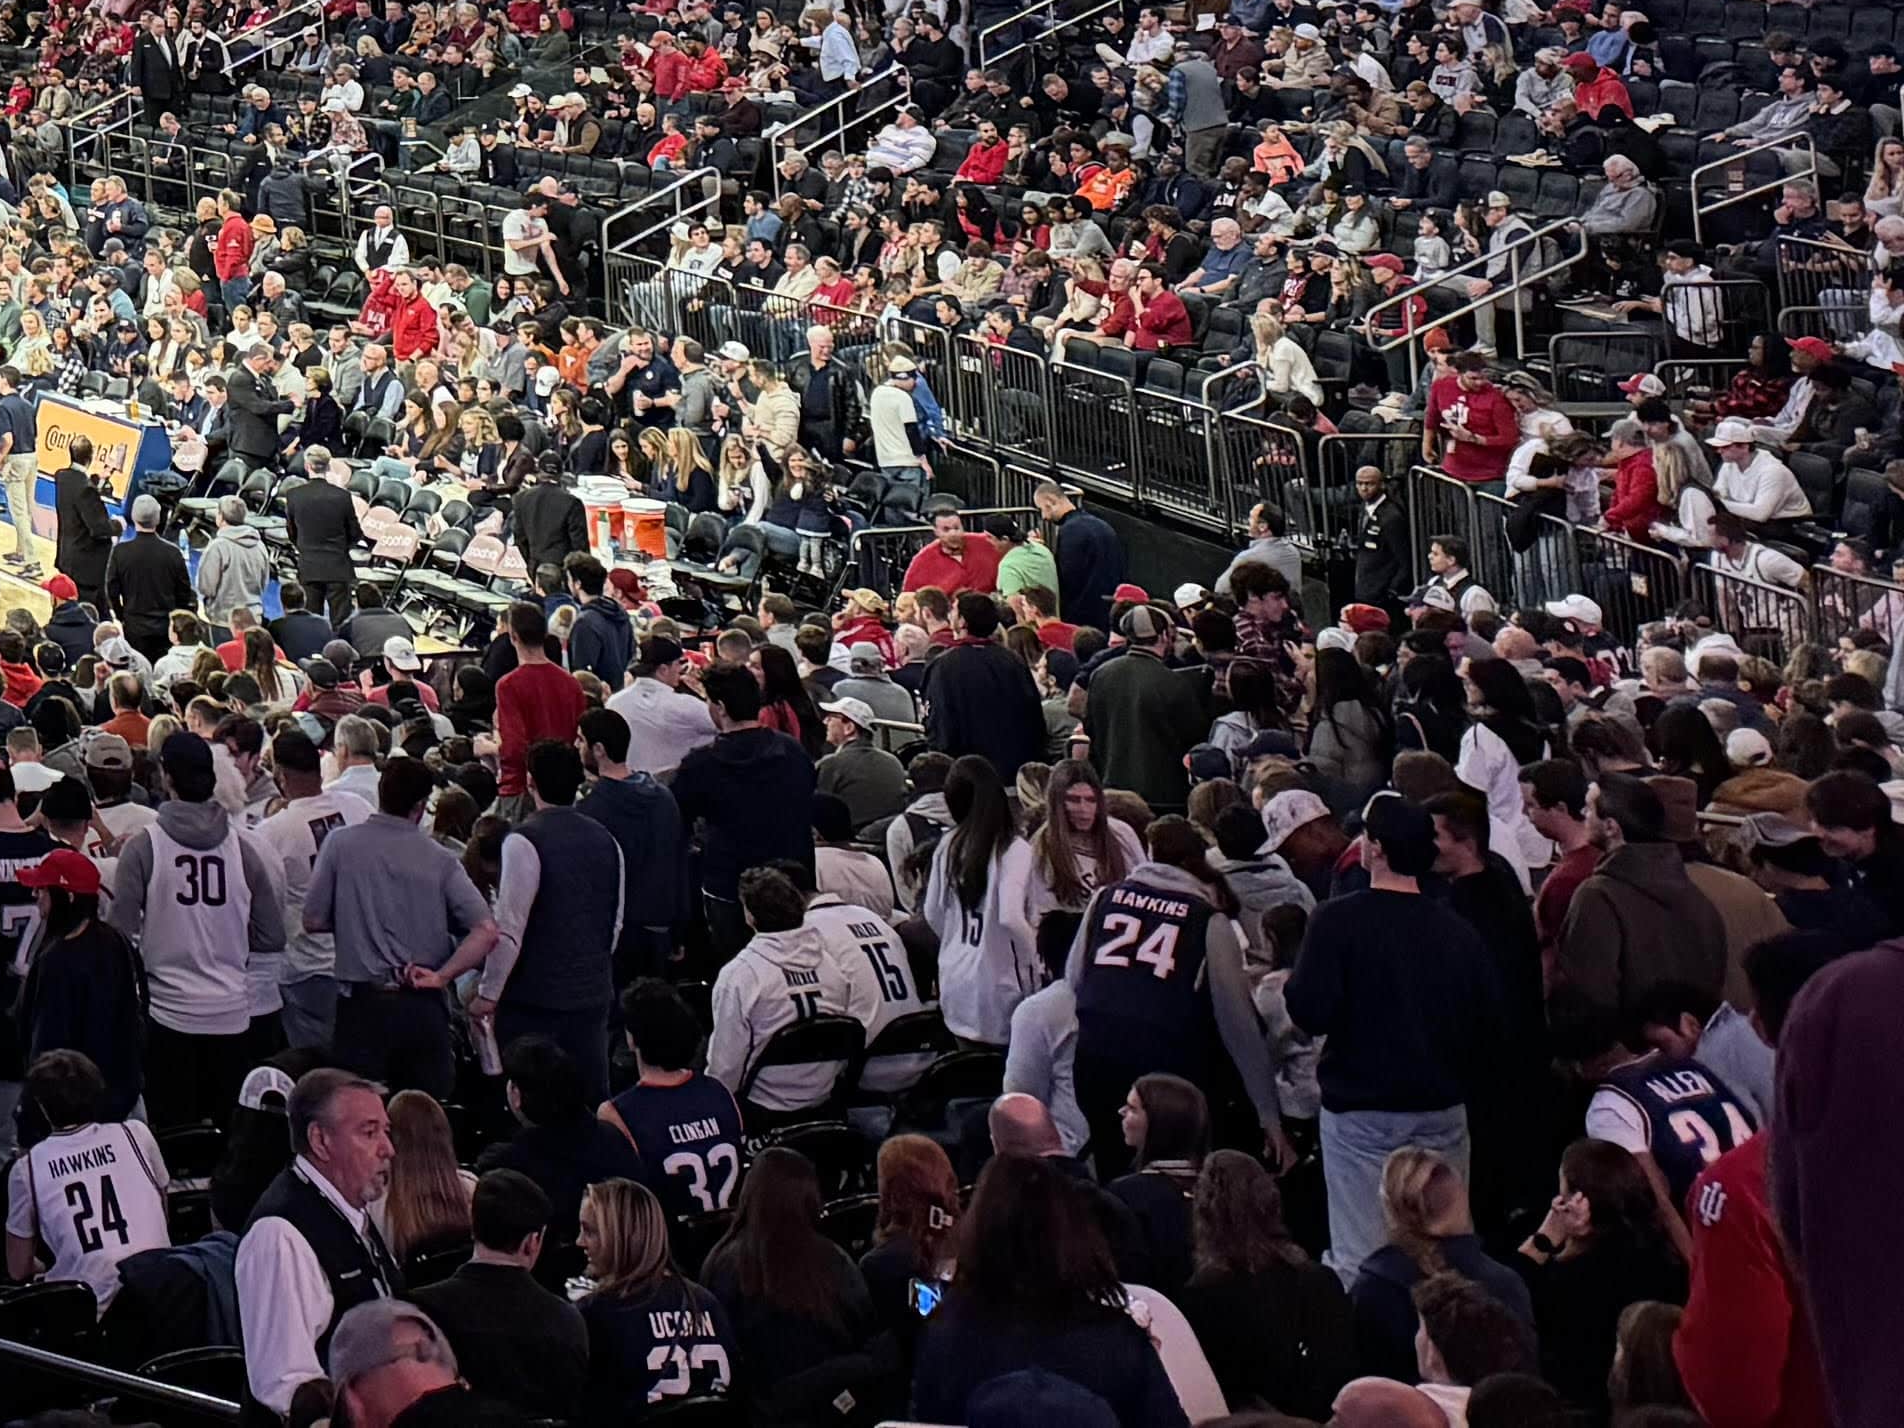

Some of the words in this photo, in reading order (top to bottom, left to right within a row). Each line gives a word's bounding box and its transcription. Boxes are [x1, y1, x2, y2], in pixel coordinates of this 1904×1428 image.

[175, 854, 227, 907] 30
[1111, 887, 1189, 919] HAWKINS
[859, 941, 909, 1004] 15
[1094, 912, 1182, 981] 24
[48, 1144, 118, 1181] HAWKINS
[63, 1174, 128, 1255] 24
